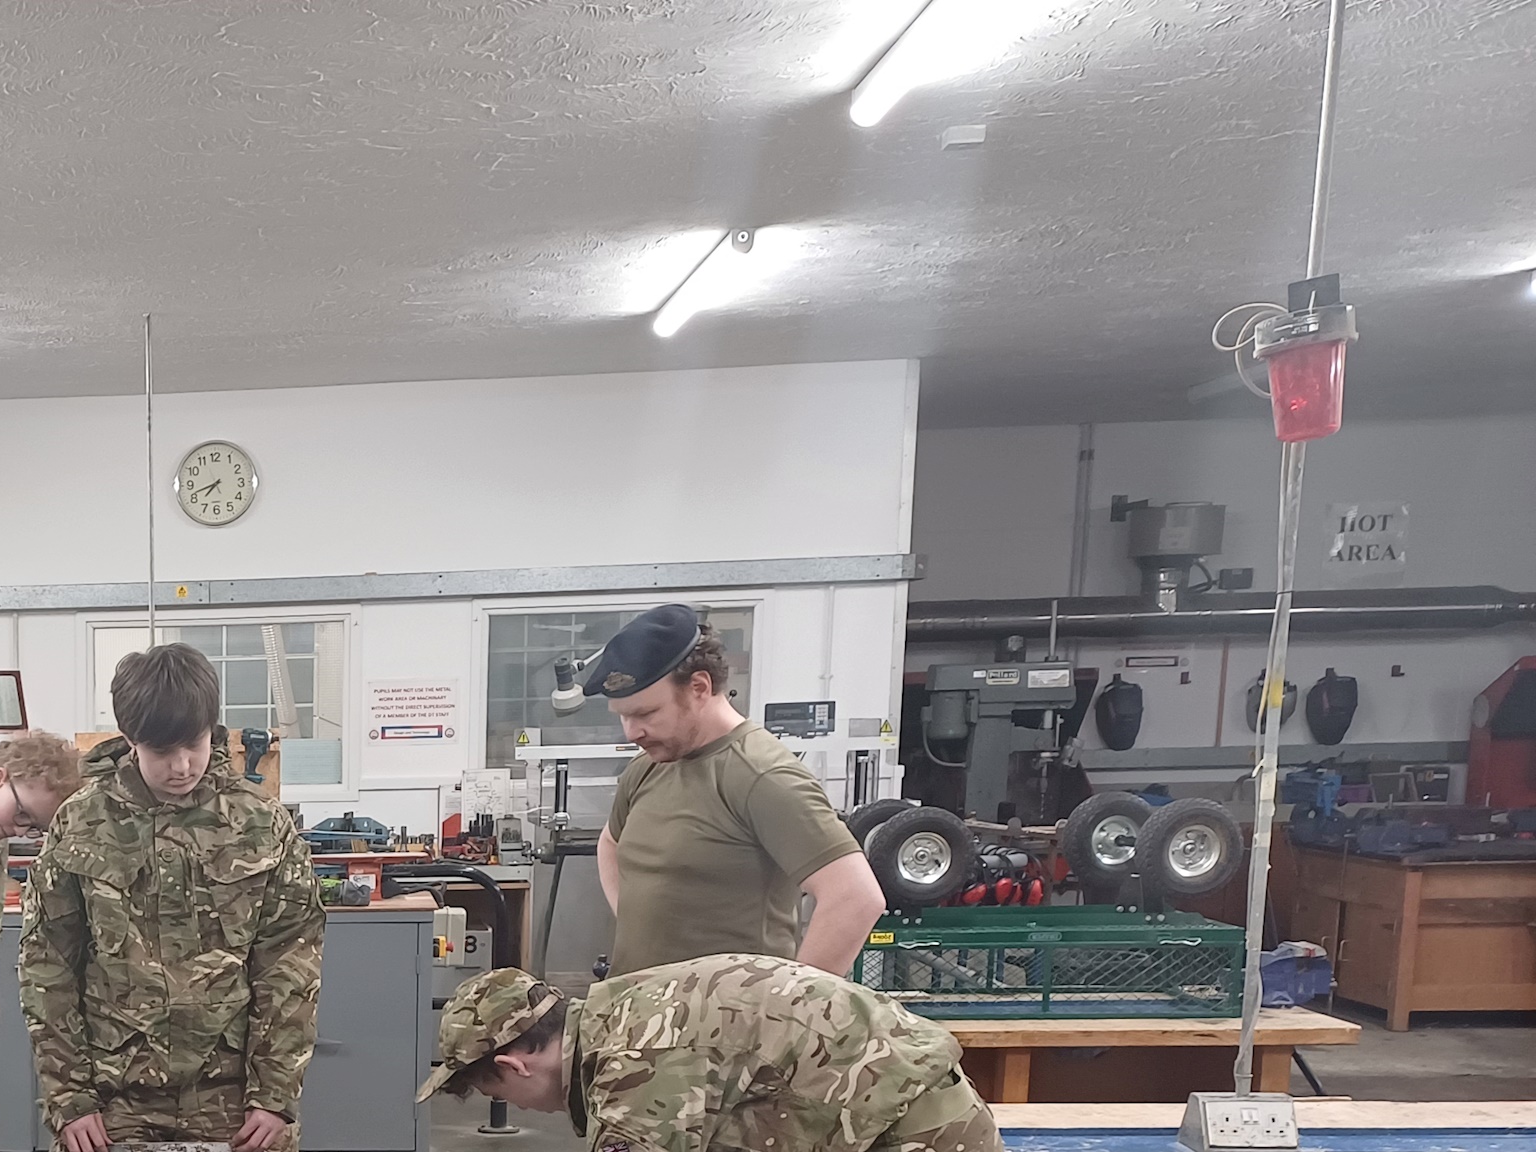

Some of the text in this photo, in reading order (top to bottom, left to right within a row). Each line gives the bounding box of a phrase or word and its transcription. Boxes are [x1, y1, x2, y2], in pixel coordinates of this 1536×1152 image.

[198, 456, 206, 466] 11
[210, 452, 221, 462] 12
[227, 454, 231, 464] 1
[188, 466, 199, 476] 10
[234, 464, 241, 474] 2
[187, 480, 194, 490] 9
[237, 477, 245, 488] 3
[190, 493, 198, 503] 8
[235, 491, 242, 500] 4
[201, 503, 208, 513] 7
[213, 504, 221, 515] 6
[226, 501, 234, 512] 5
[1338, 514, 1394, 534] HOT
[1328, 544, 1396, 561] AREA
[465, 935, 477, 953] 8
